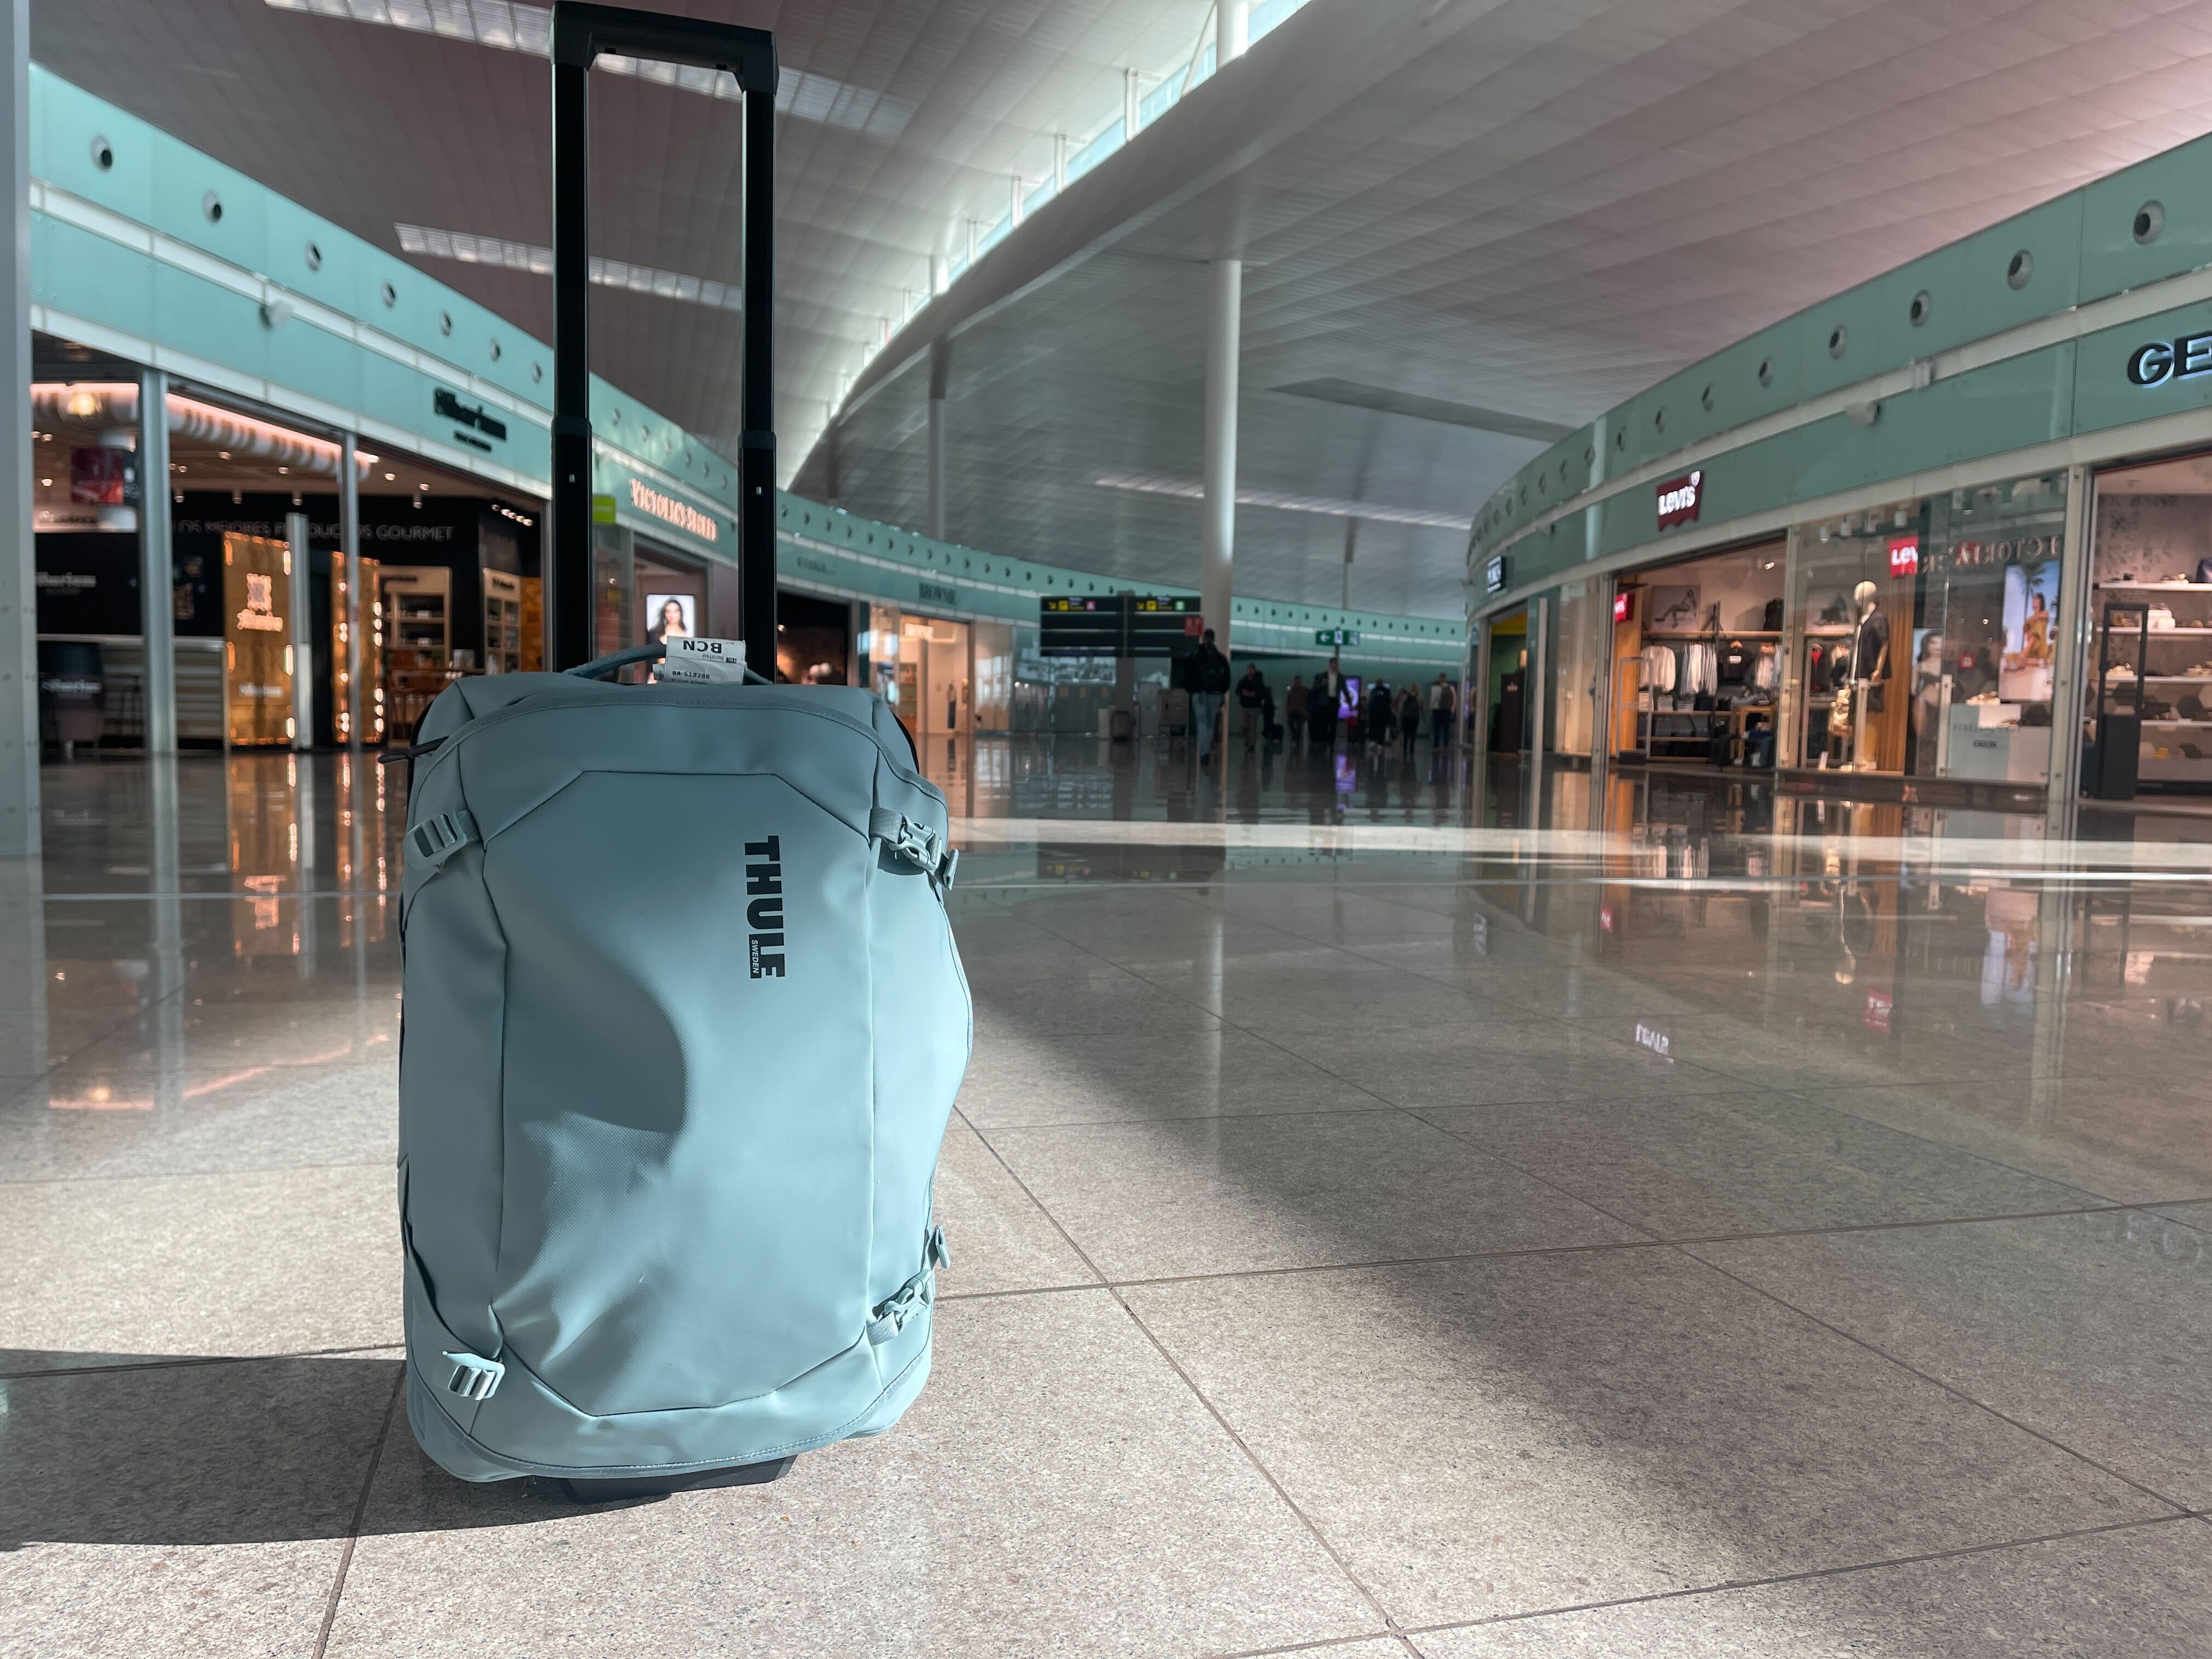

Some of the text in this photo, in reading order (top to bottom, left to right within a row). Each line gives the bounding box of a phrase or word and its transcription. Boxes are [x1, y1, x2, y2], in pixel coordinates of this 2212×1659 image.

[683, 640, 722, 654] BCN
[744, 835, 785, 979] THULE
[752, 939, 760, 974] SWEDEN
